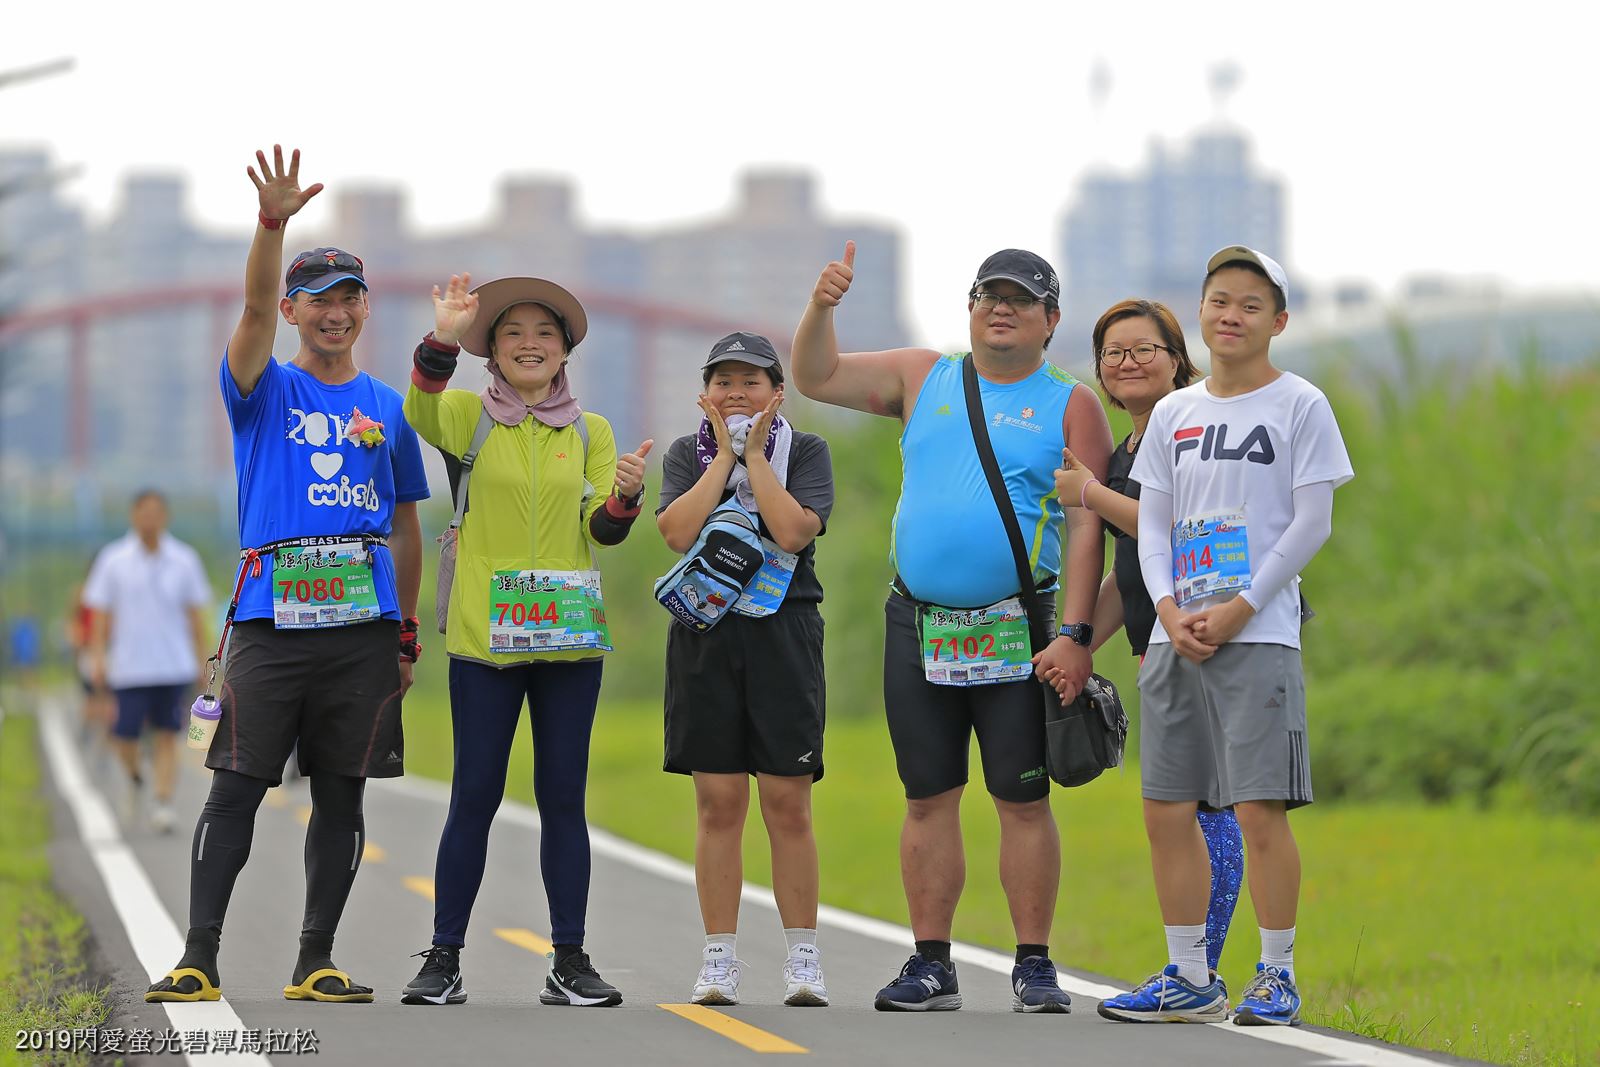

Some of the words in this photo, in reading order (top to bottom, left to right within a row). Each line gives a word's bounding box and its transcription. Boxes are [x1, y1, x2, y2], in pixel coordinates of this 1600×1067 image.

[1174, 423, 1275, 467] FILA
[301, 536, 341, 546] BEAST
[719, 546, 744, 563] SNOOPY
[278, 577, 345, 603] 7080
[495, 601, 560, 626] 7044
[668, 596, 699, 625] SNOOPY
[929, 634, 997, 662] 7102
